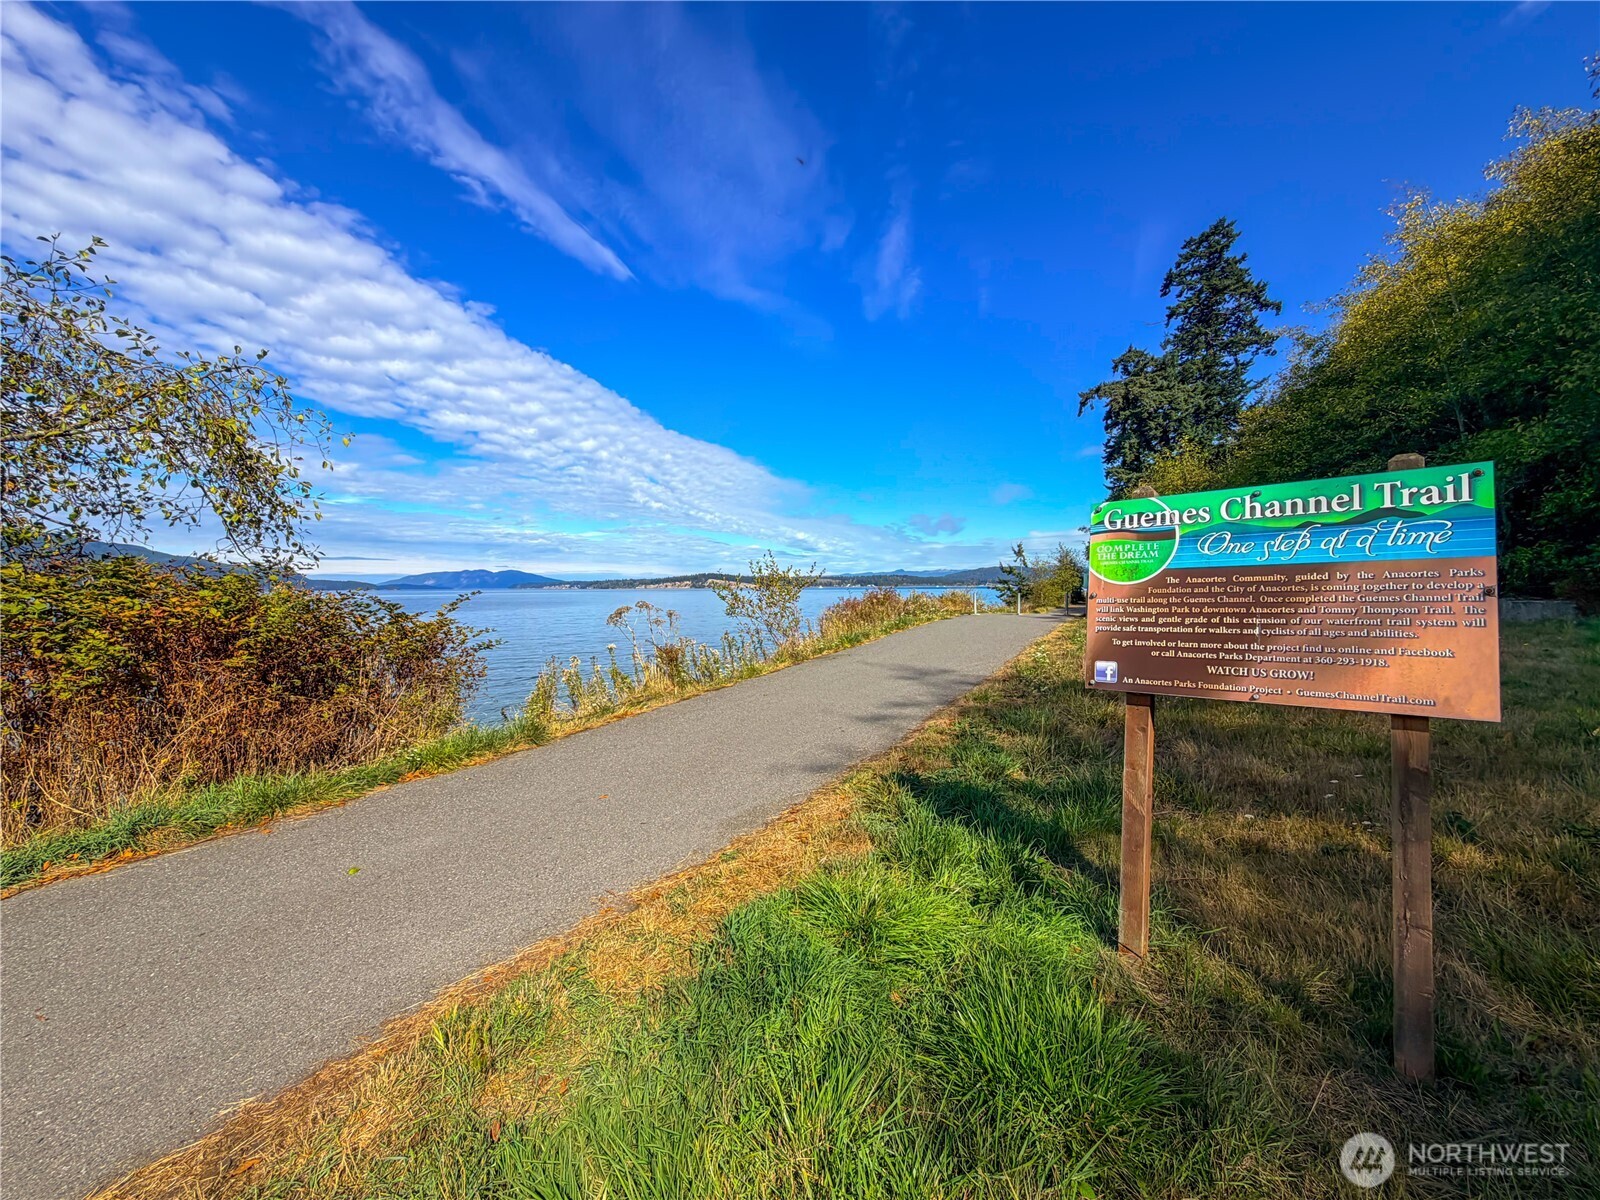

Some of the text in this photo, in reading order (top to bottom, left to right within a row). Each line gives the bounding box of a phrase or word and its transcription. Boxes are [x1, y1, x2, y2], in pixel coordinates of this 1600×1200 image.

[1104, 472, 1474, 530] Guemes Channel Trail
[1096, 542, 1160, 553] COMPLETE
[1197, 530, 1255, 556] One
[1257, 524, 1322, 562] step
[1320, 526, 1350, 559] at
[1376, 519, 1453, 555] time
[1097, 550, 1159, 561] THE DREAM
[1165, 576, 1180, 584] The
[1185, 575, 1226, 583] Anacortes
[1232, 574, 1288, 583] Community,
[1295, 572, 1329, 582] guided
[1337, 571, 1349, 582] by
[1383, 570, 1439, 579] Anacortes
[1450, 568, 1484, 578] Parks
[1148, 586, 1192, 594] Foundation
[1211, 585, 1225, 593] the
[1226, 585, 1244, 594] City
[1247, 584, 1257, 592] of
[1258, 583, 1308, 592] Anacortes,
[1310, 584, 1319, 592] is
[1321, 583, 1360, 592] coming
[1362, 582, 1409, 592] together
[1412, 582, 1423, 590] to
[1426, 581, 1474, 592] develop
[1130, 596, 1146, 604] trail
[1147, 596, 1168, 605] along
[1169, 596, 1182, 604] the
[1217, 595, 1255, 603] Channel.
[1260, 595, 1283, 603] Once
[1285, 594, 1336, 604] completed
[1336, 594, 1355, 602] the
[1357, 594, 1400, 602] Guemes
[1403, 593, 1452, 602] Channel
[1455, 593, 1484, 601] Trail
[1126, 606, 1170, 614] Washington
[1250, 606, 1296, 614] Anacortes
[1298, 606, 1316, 614] and
[1319, 606, 1357, 616] Tommy
[1361, 605, 1419, 616] Thompson
[1422, 605, 1454, 614] Trail.
[1462, 605, 1486, 614] The
[1158, 616, 1182, 625] gentle
[1185, 617, 1208, 625] grade
[1211, 616, 1221, 624] of
[1223, 616, 1240, 624] this
[1243, 616, 1286, 625] extension
[1291, 617, 1302, 625] of
[1326, 617, 1381, 626] waterfront
[1387, 618, 1410, 626] trail
[1416, 619, 1457, 628] system
[1462, 618, 1486, 627] will
[1095, 625, 1121, 633] provide
[1138, 625, 1193, 634] transportation
[1243, 627, 1259, 635] and
[1261, 627, 1294, 636] cyclists
[1297, 628, 1308, 636] of
[1309, 628, 1321, 636] all
[1323, 630, 1346, 639] ages
[1348, 629, 1368, 637] and
[1370, 629, 1418, 638] abilities.
[1135, 639, 1166, 647] involved
[1178, 640, 1199, 648] learn
[1223, 642, 1248, 650] about
[1267, 643, 1299, 653] project
[1338, 646, 1372, 654] online
[1374, 647, 1395, 655] and
[1399, 648, 1454, 658] Facebook
[1177, 650, 1217, 659] Anacortes
[1219, 652, 1243, 660] Parks
[1245, 653, 1300, 664] Department
[1315, 657, 1389, 667] 360-293-1918.
[1207, 666, 1315, 681] WATCH US GROW!
[1135, 678, 1172, 687] Anacortes
[1174, 680, 1196, 688] Parks
[1198, 682, 1247, 692] Foundation
[1250, 685, 1282, 695] Project
[1296, 688, 1435, 706] GuemesChannelTrail.com
